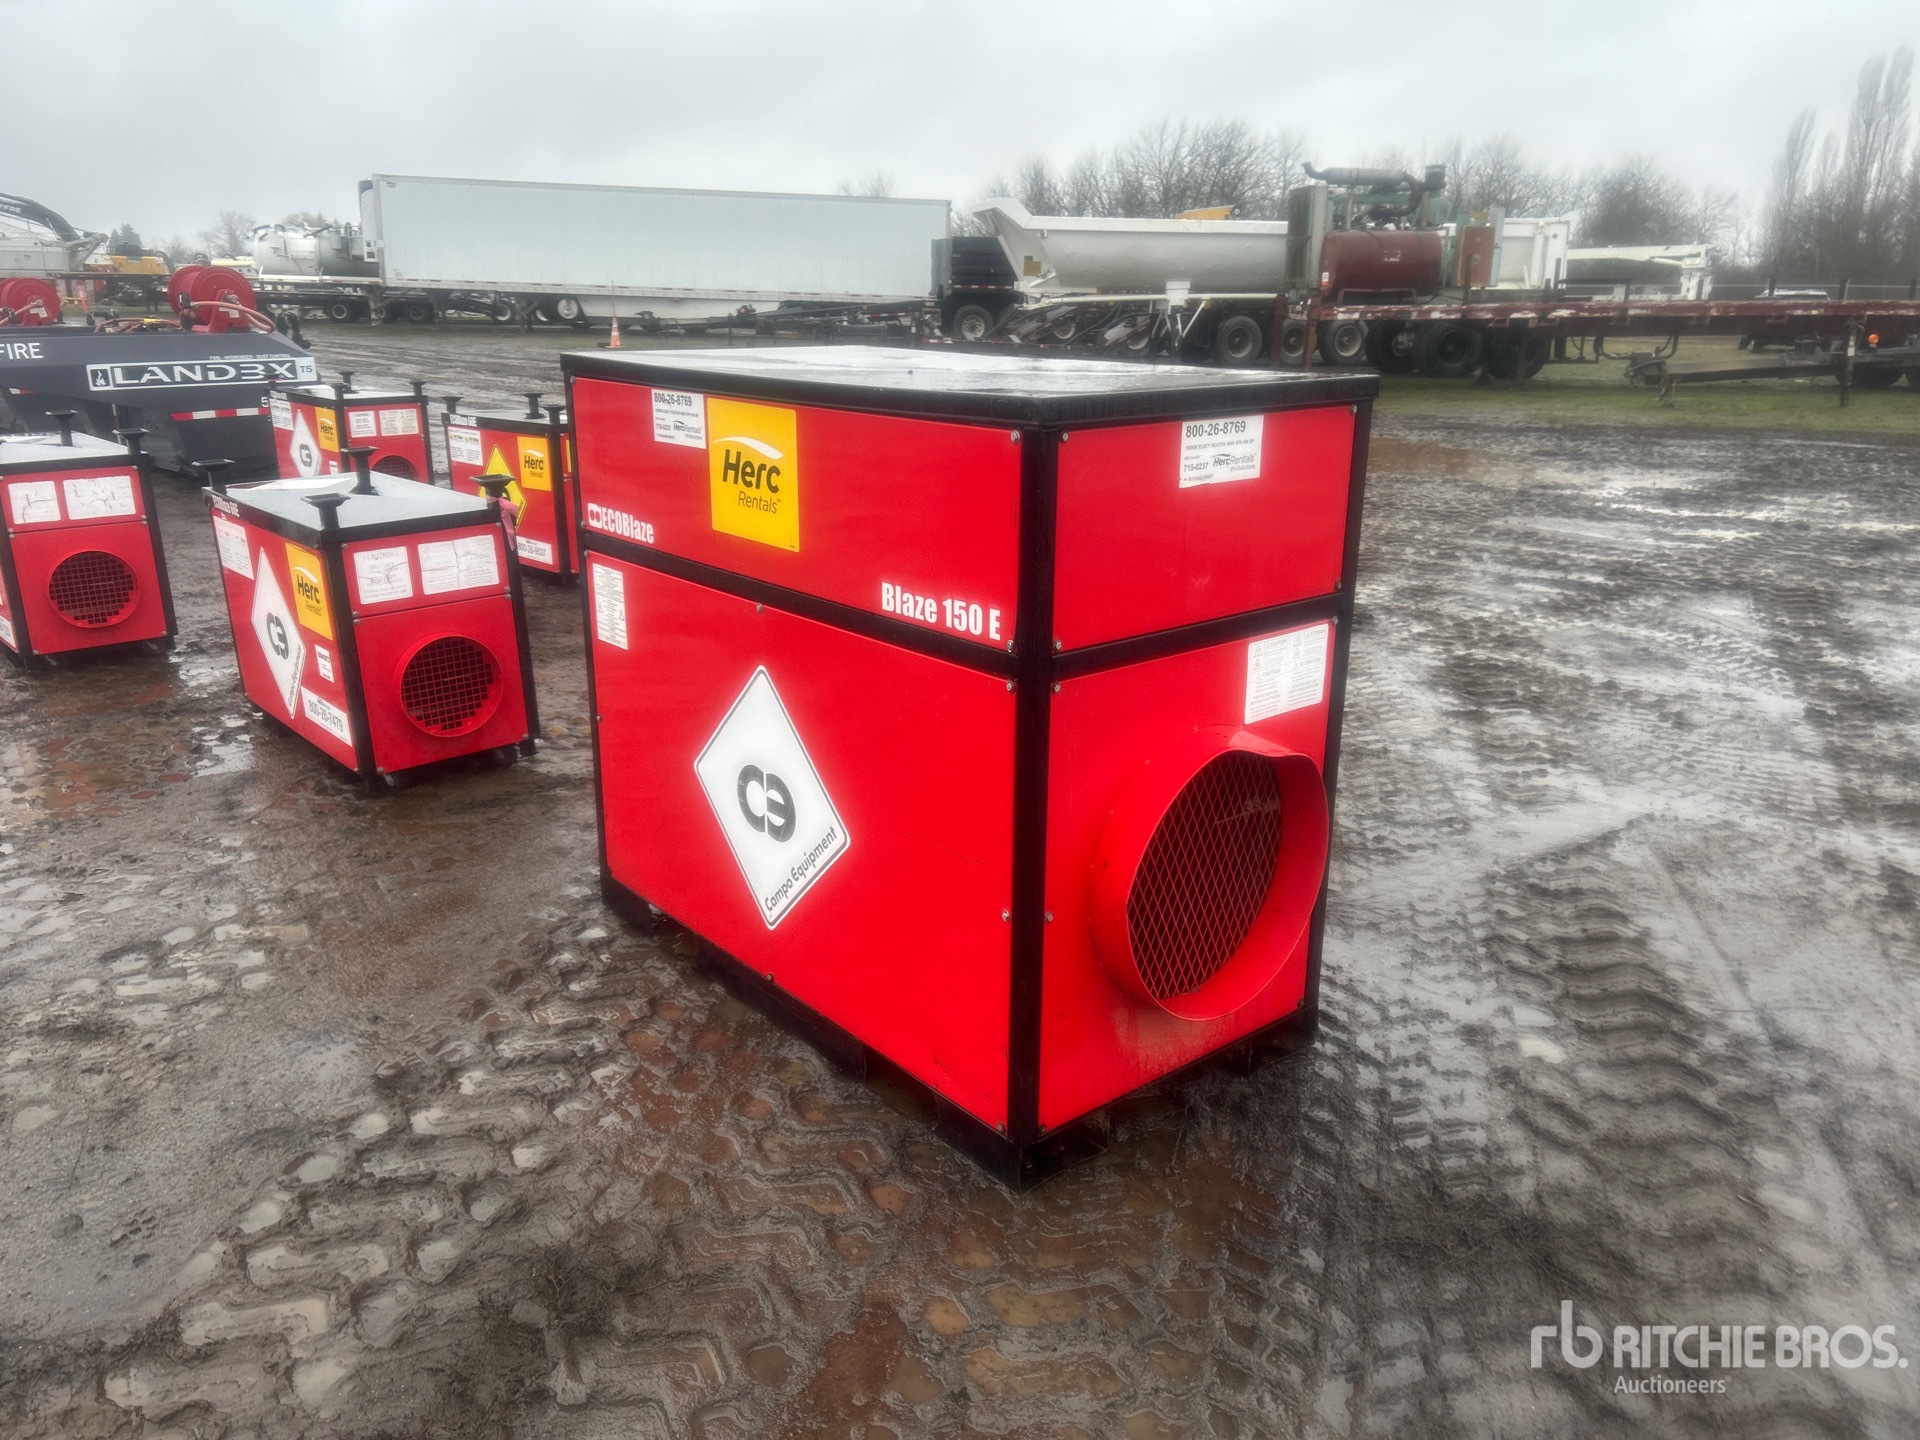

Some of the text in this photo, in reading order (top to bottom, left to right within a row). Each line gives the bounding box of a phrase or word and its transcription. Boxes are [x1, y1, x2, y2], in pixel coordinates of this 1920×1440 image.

[299, 364, 313, 374] T5
[653, 391, 693, 407] 800-26-8769
[320, 422, 334, 436] Herc
[1185, 420, 1246, 438] 800-26-8769
[523, 454, 545, 471] Herc
[722, 448, 782, 494] Herc
[601, 506, 655, 544] ECOBlaze
[296, 574, 321, 604] Herc
[881, 581, 1001, 641] Blaze 150 E
[764, 826, 838, 912] Campo Equipment
